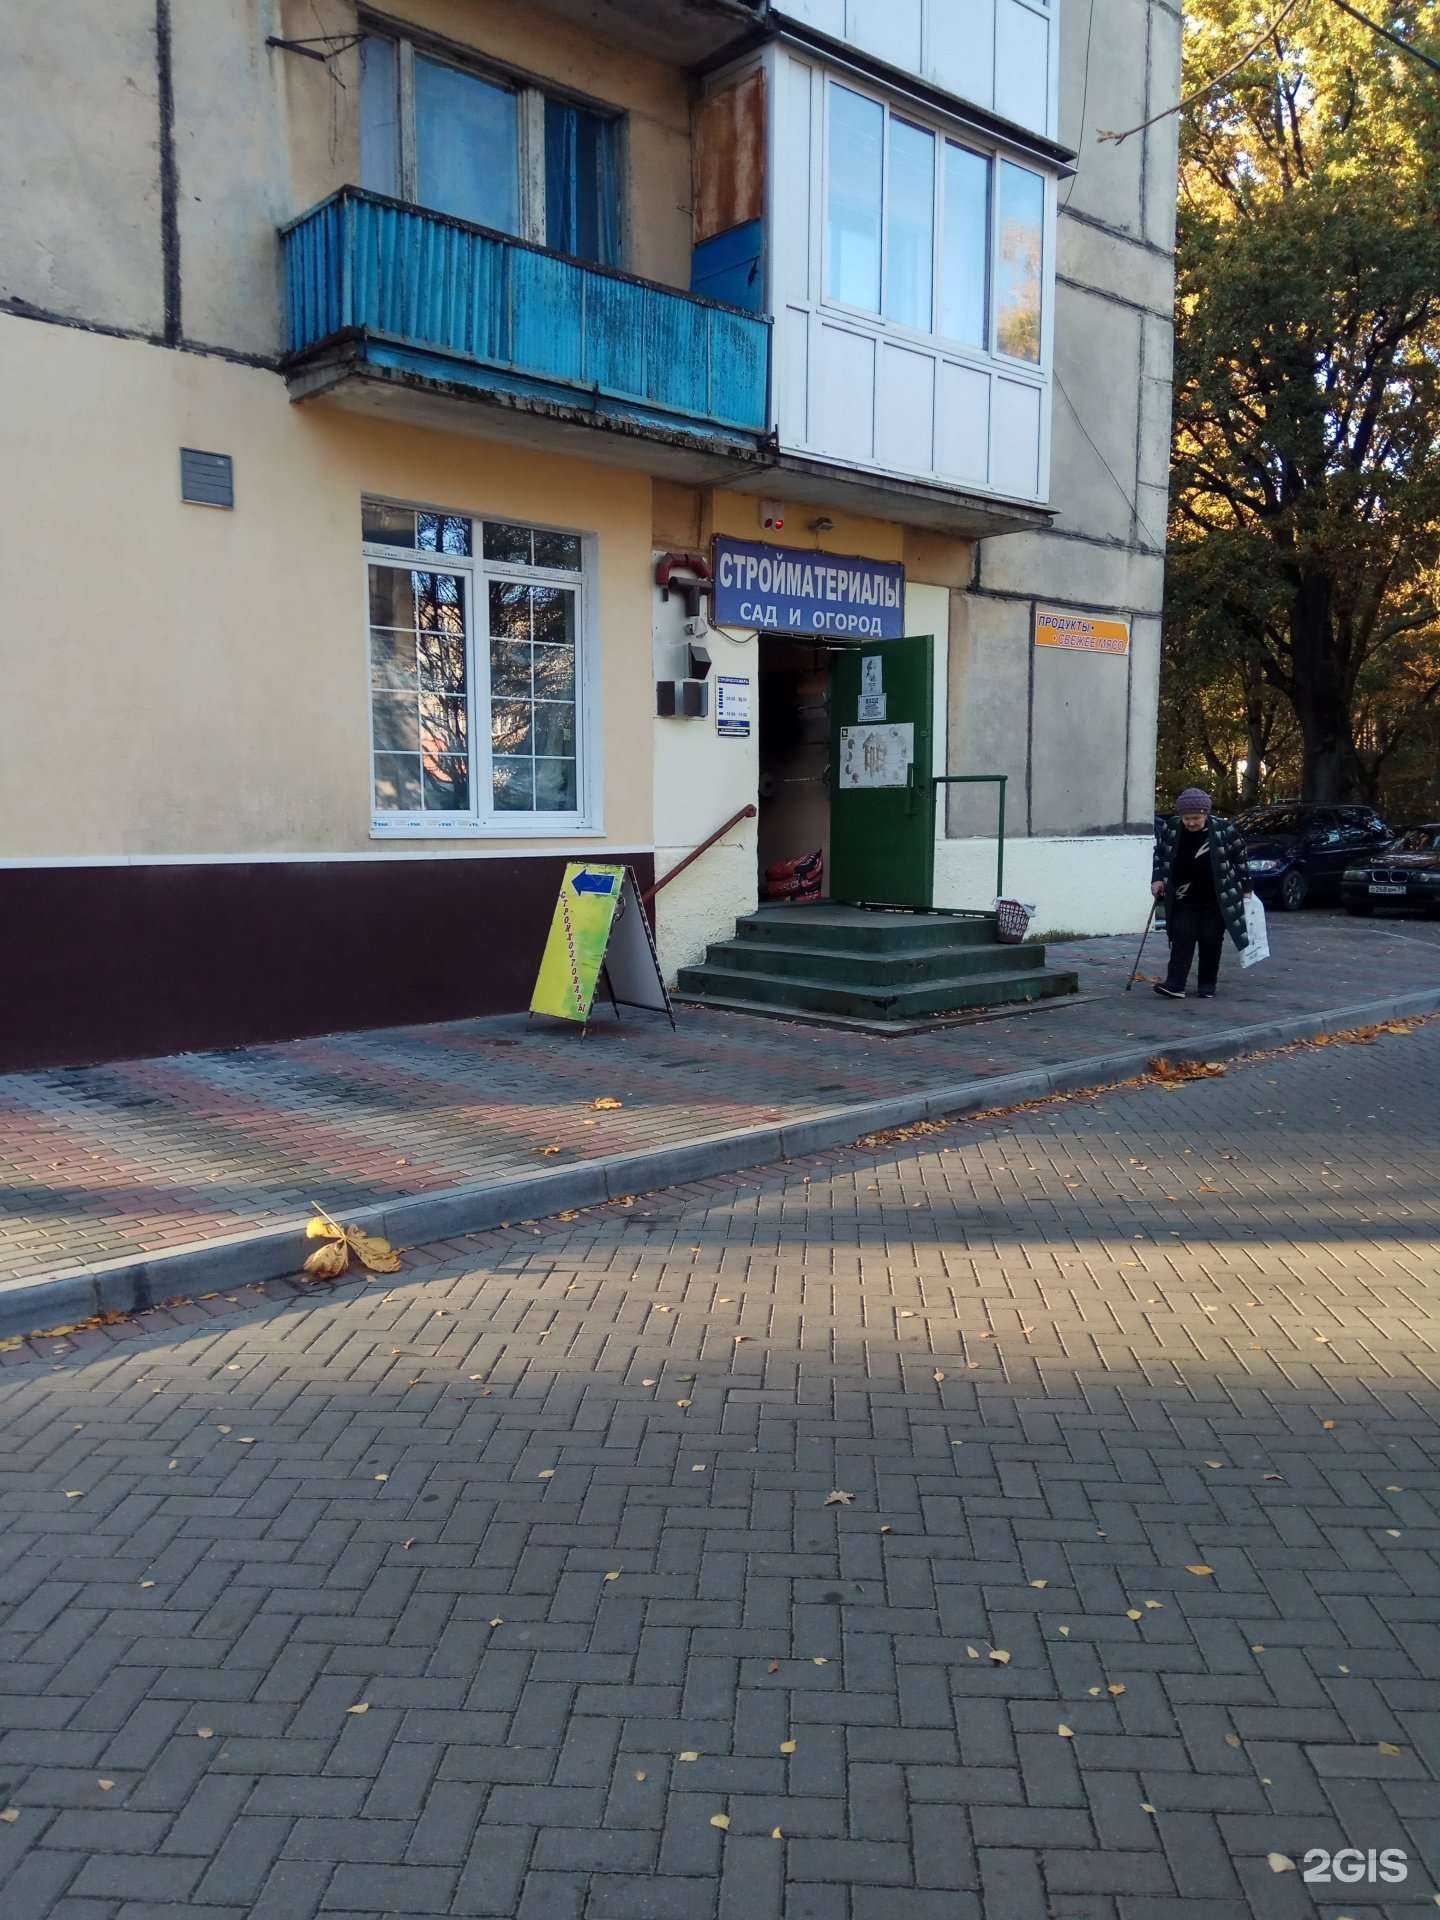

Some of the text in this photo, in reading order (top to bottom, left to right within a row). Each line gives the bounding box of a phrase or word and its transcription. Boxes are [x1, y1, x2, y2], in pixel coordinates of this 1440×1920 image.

[719, 552, 900, 608] СТРОЙМАТЕРИАЛЫ
[740, 602, 882, 637] САД И ОГОРОД
